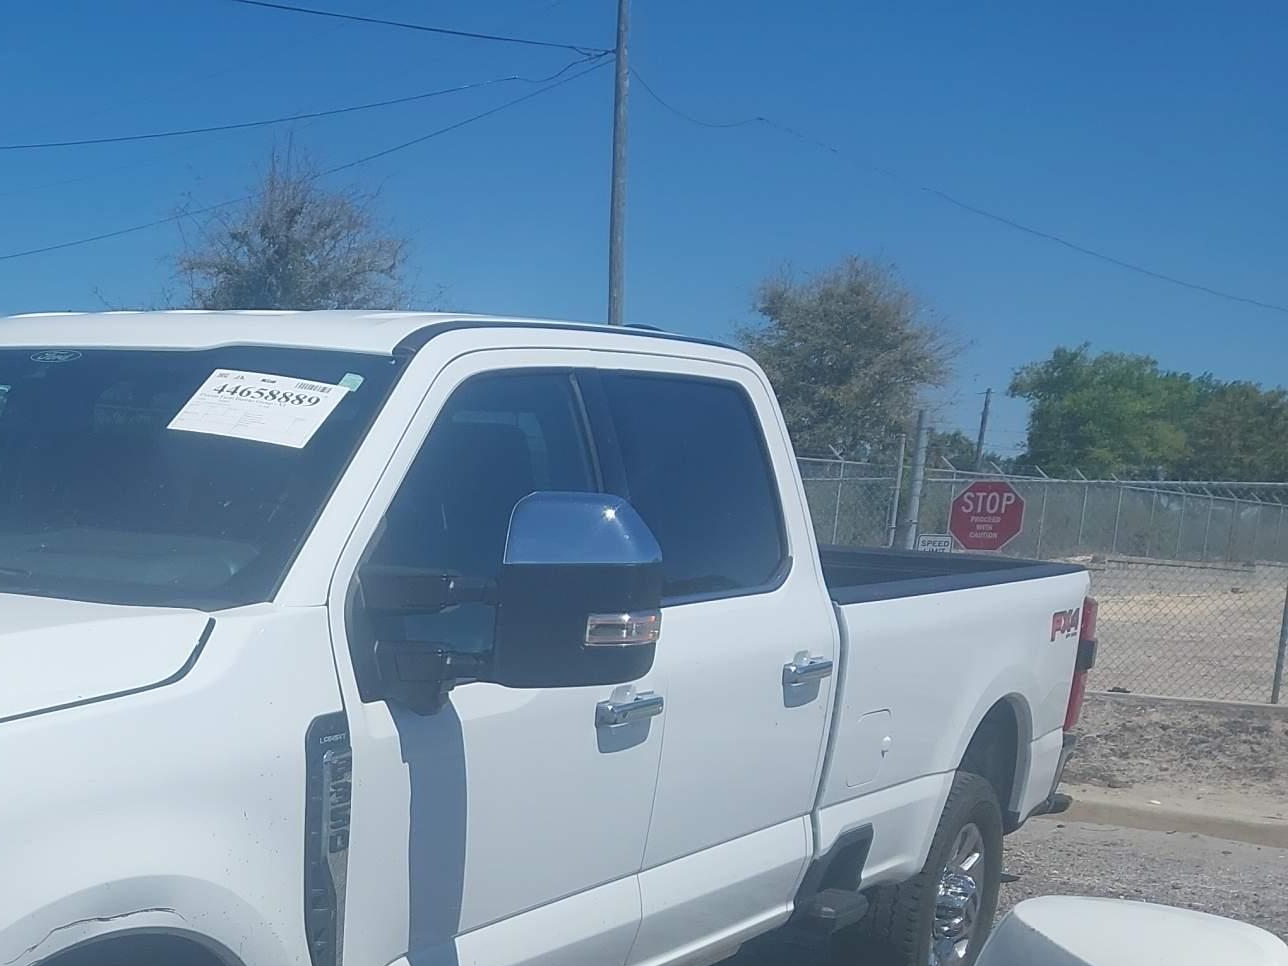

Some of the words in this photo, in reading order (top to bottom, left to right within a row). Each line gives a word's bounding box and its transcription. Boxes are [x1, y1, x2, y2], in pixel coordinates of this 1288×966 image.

[213, 383, 321, 407] 44658889
[962, 492, 1016, 514] STOP
[970, 515, 1001, 523] PROCEED
[920, 540, 950, 548] SPEED
[1051, 608, 1080, 642] FX4
